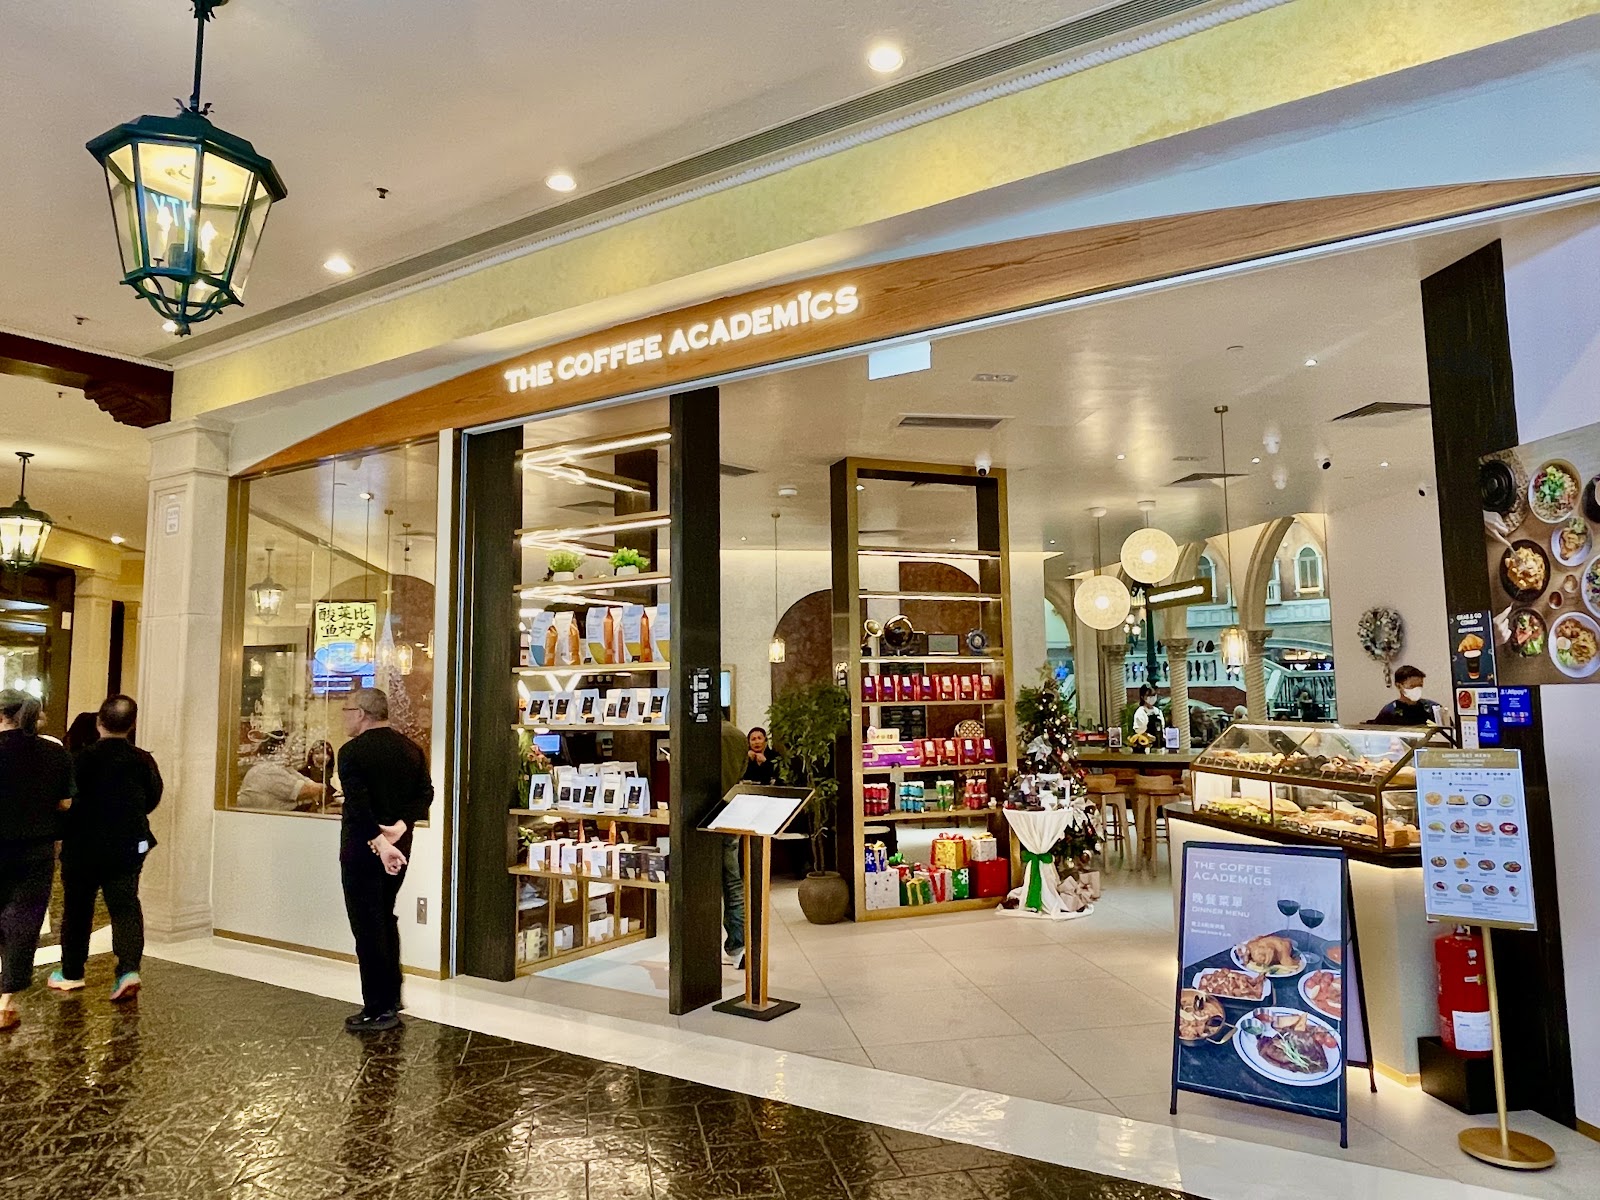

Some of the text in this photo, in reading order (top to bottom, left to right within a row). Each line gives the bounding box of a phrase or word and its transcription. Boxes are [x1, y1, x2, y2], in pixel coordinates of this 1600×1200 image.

[504, 361, 553, 393] THE
[557, 334, 663, 380] COFFEE
[1194, 861, 1272, 875] THE COFFEE
[1226, 910, 1250, 918] MENU
